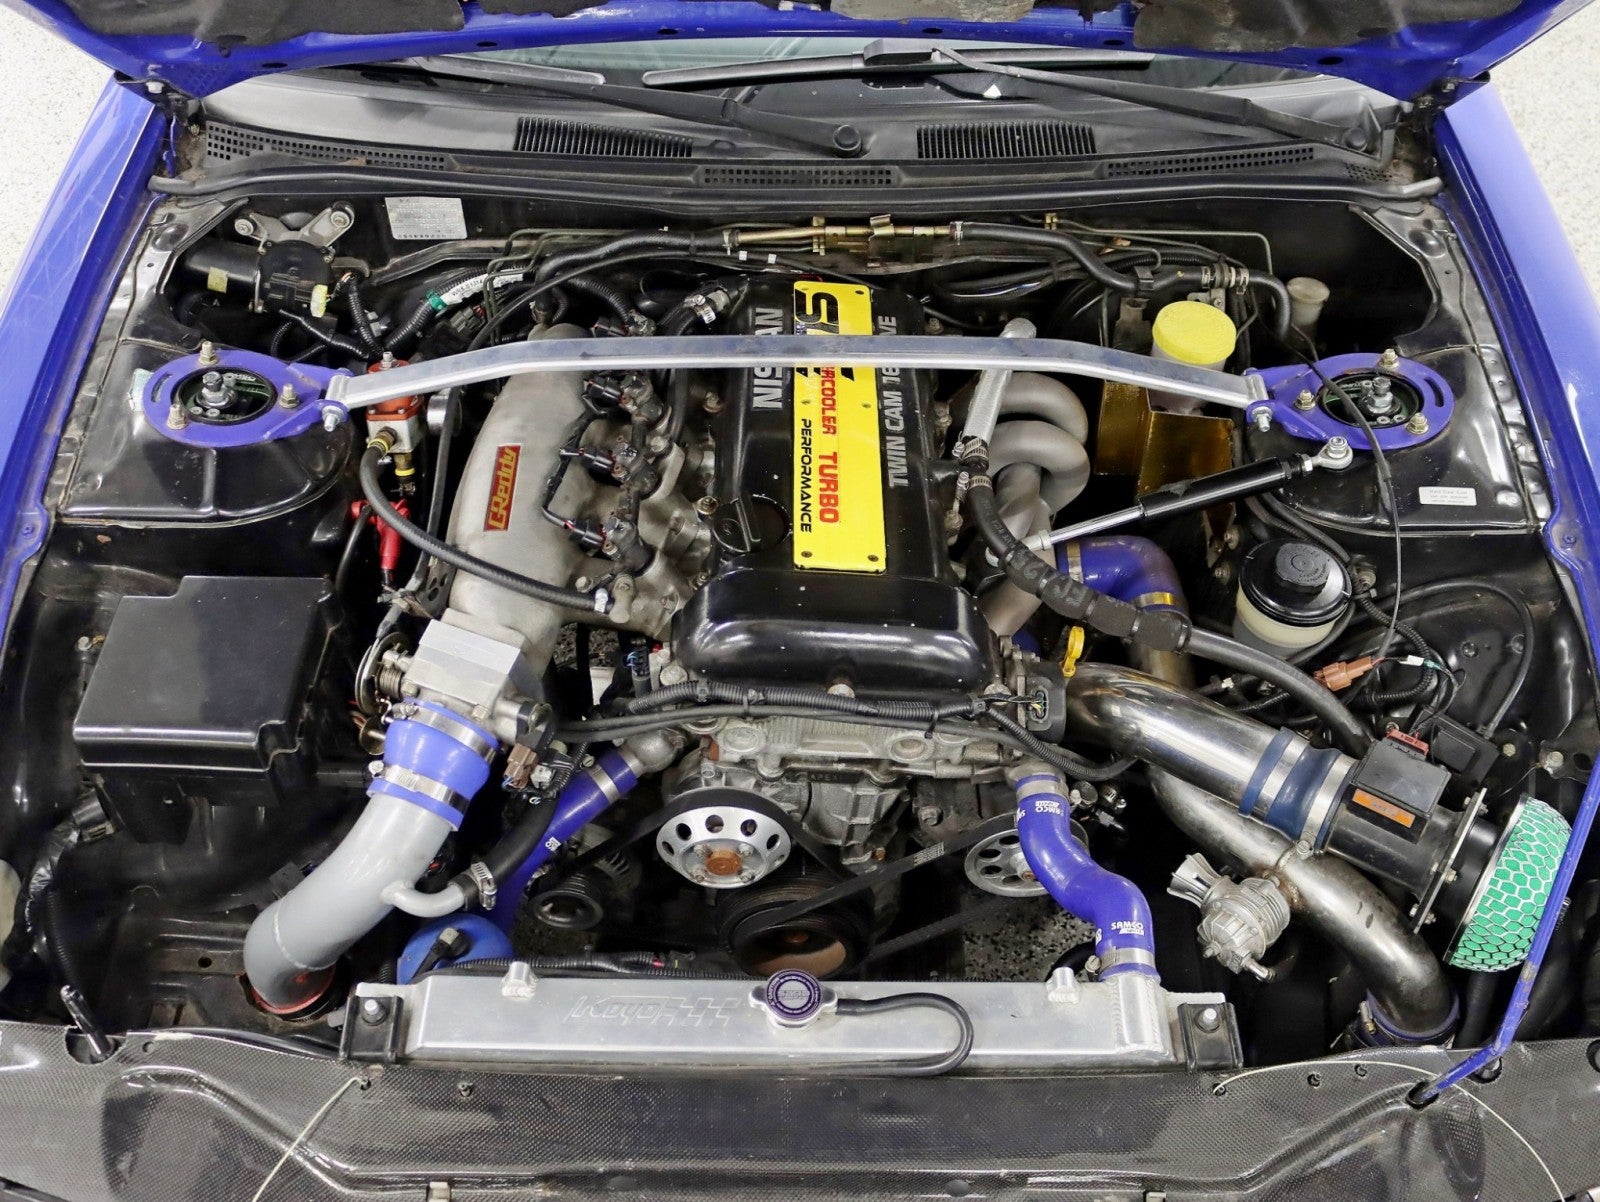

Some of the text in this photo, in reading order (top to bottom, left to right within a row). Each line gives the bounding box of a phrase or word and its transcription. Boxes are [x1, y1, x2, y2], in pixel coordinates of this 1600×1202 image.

[753, 307, 783, 410] NISAN
[883, 390, 905, 432] CAM
[800, 417, 812, 533] PERFORMANCE
[818, 451, 840, 523] TURBO
[886, 436, 908, 488] TWIN
[1110, 920, 1144, 931] SAMCO
